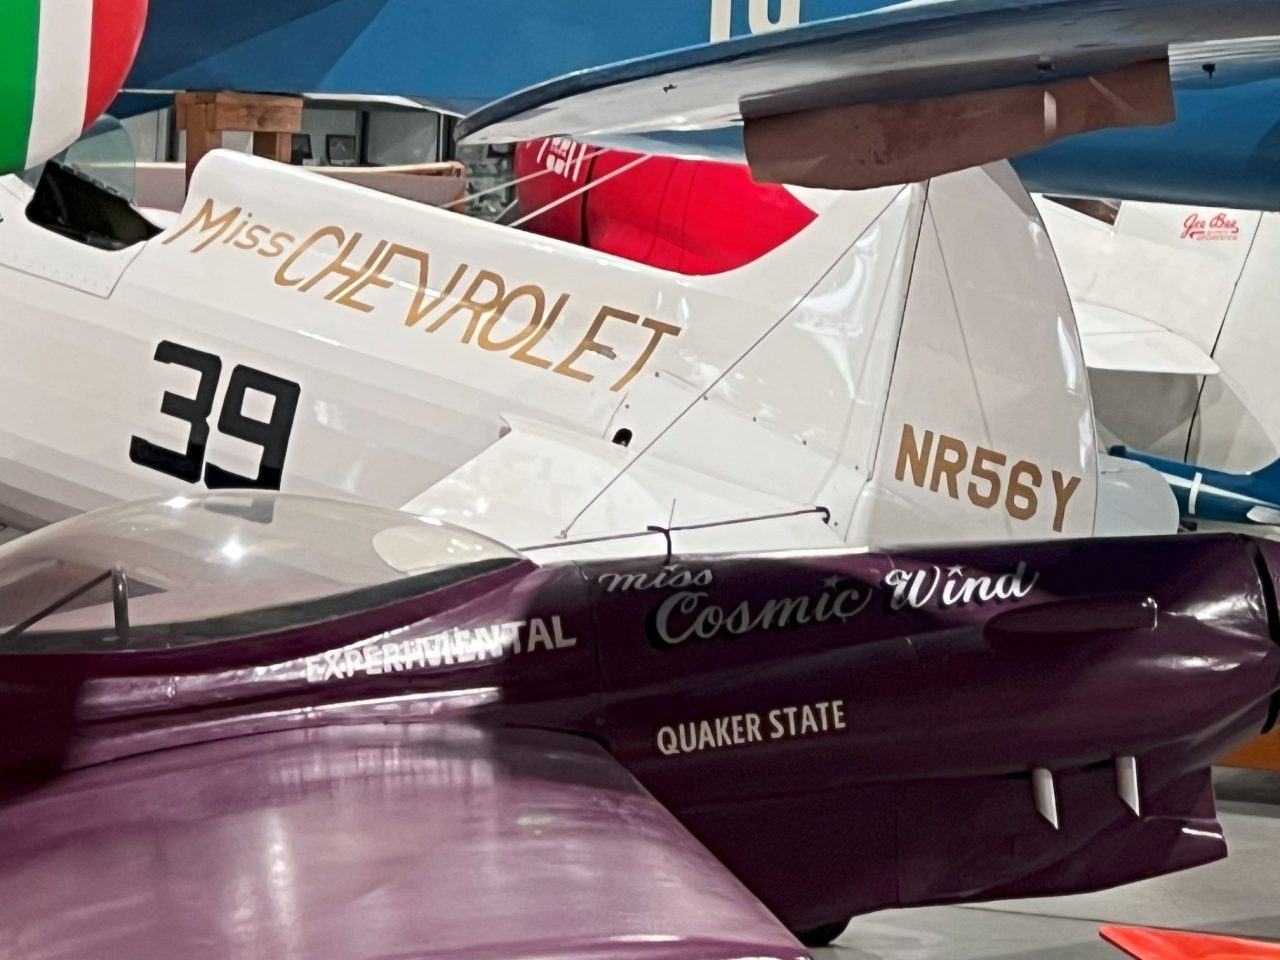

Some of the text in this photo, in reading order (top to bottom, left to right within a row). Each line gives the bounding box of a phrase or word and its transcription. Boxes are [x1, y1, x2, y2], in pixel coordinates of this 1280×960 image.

[161, 197, 682, 393] Miss CHEVROLET
[128, 339, 302, 492] 39
[894, 423, 1082, 533] NR56Y
[598, 566, 713, 592] miss
[654, 561, 1038, 646] Cosmic Wind
[305, 615, 578, 684] EXPERIMENTAL
[656, 700, 847, 756] QUAKER STATE
